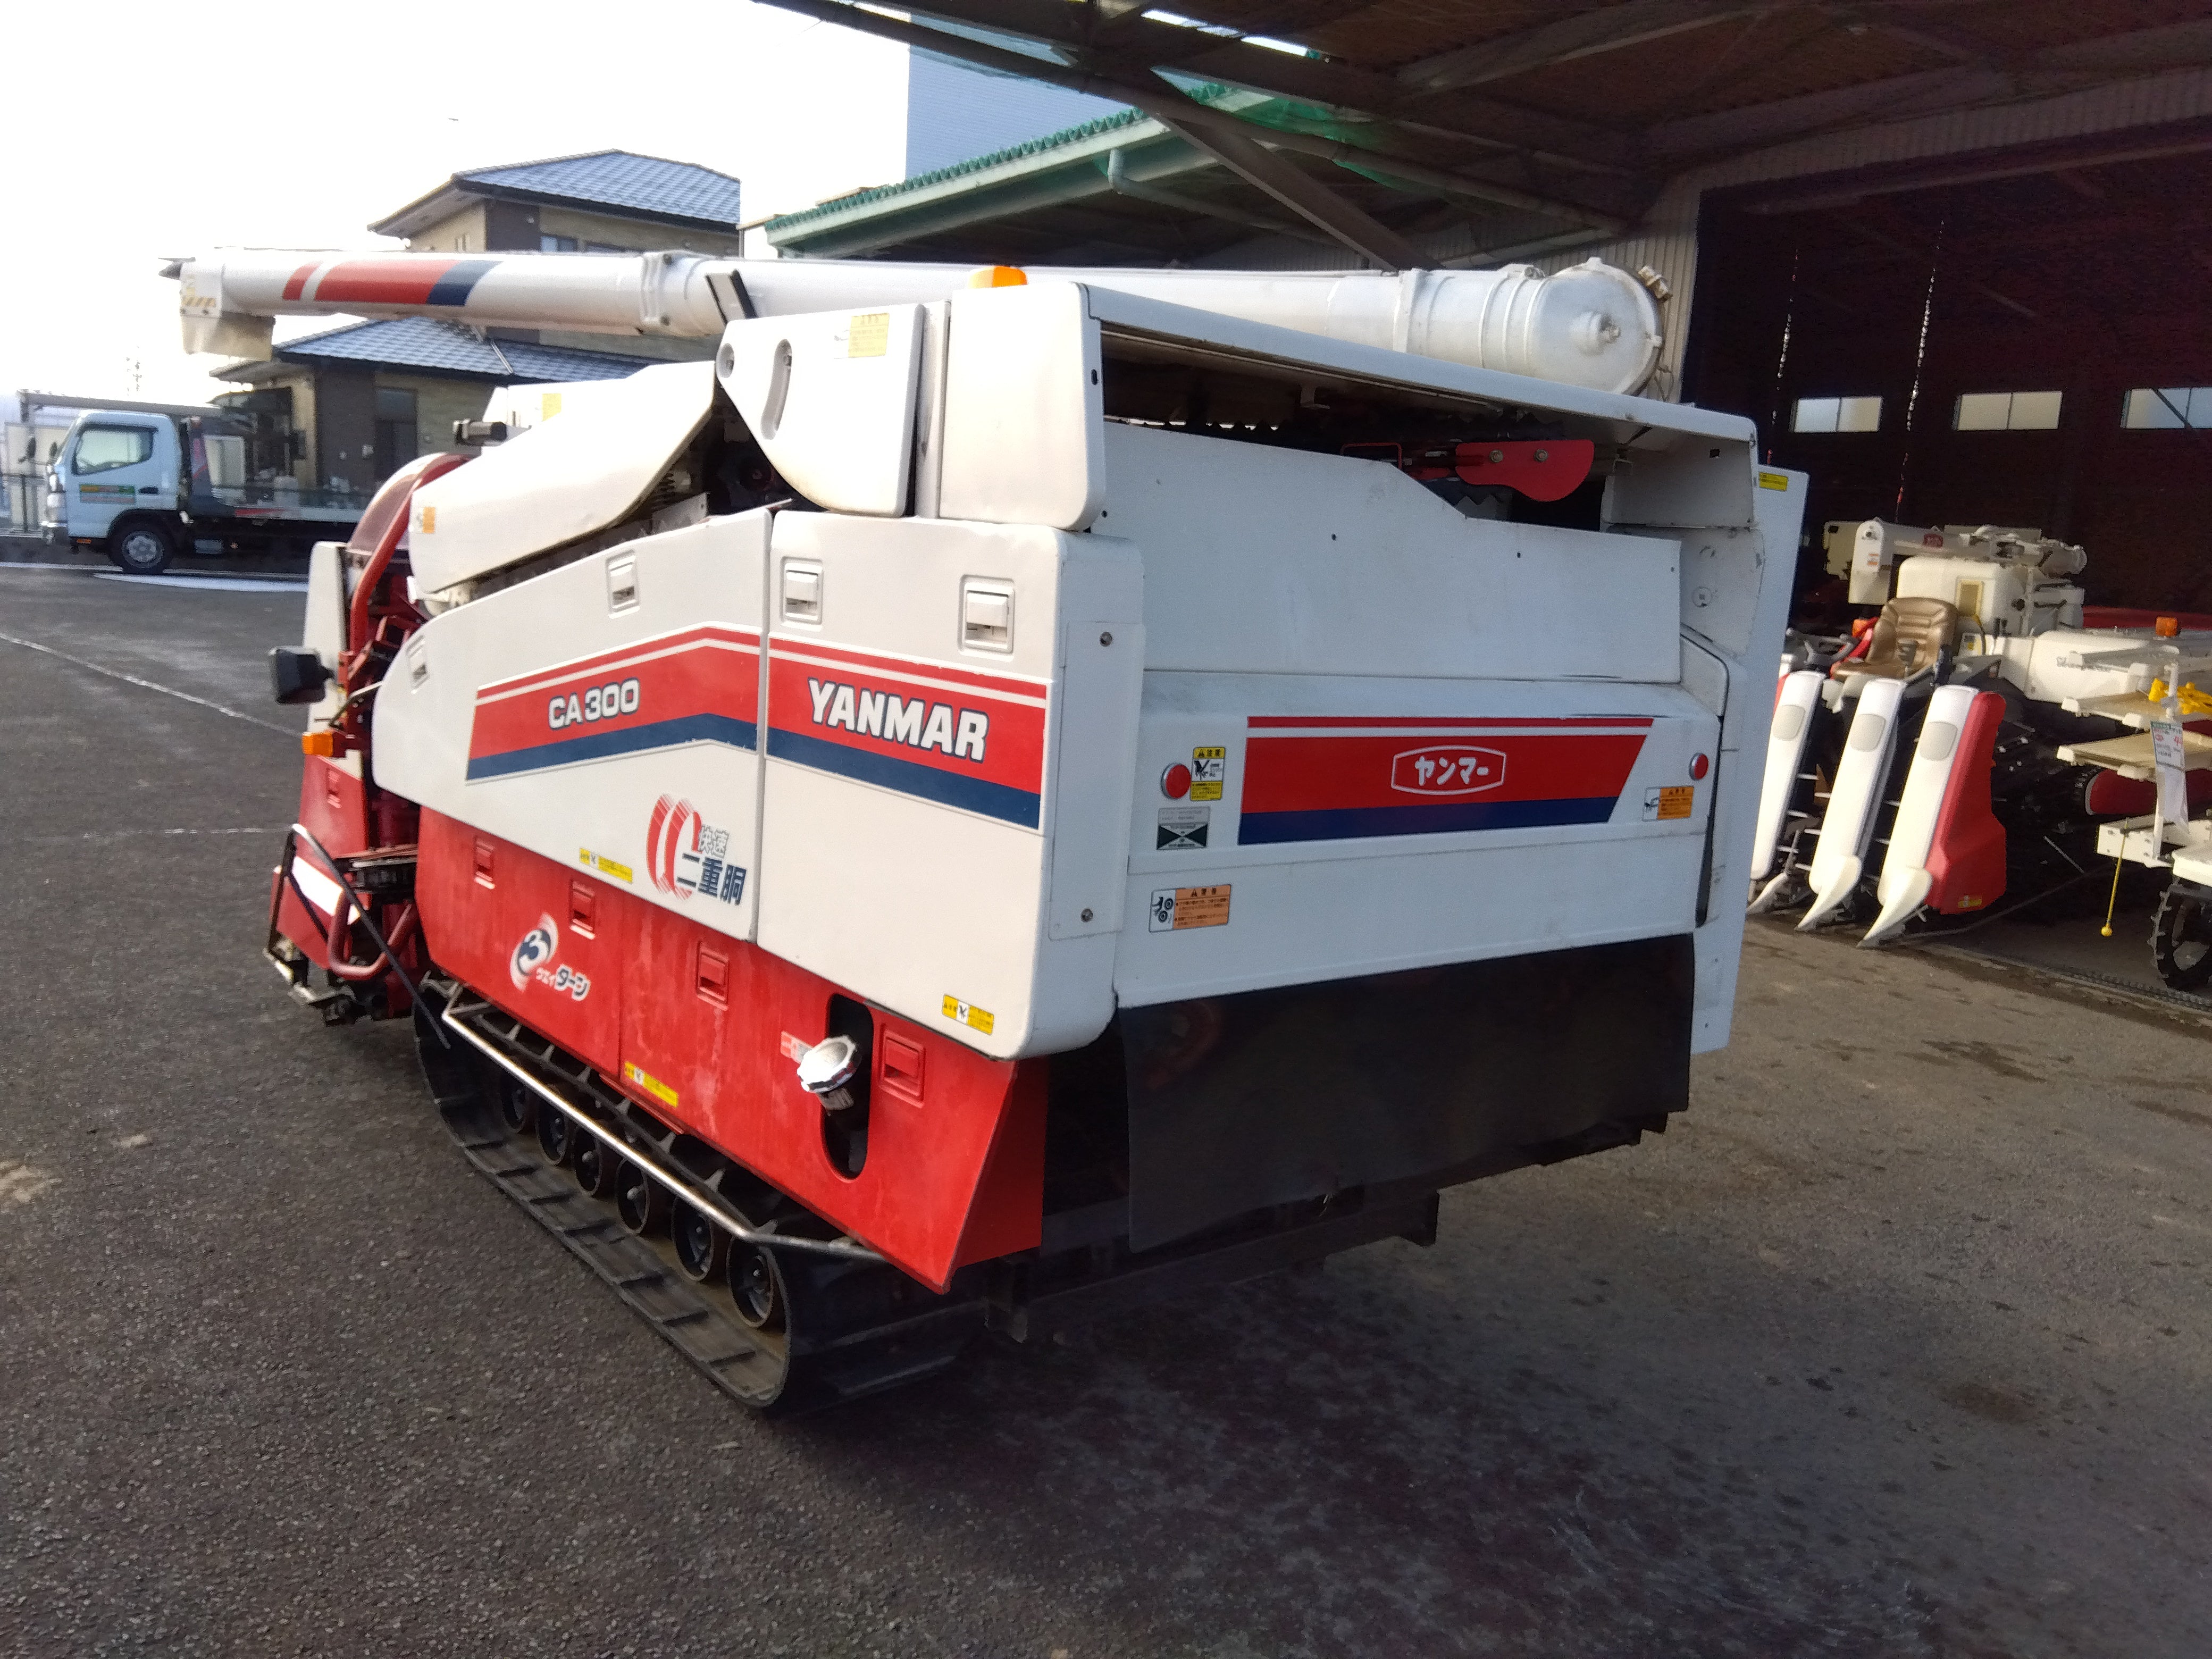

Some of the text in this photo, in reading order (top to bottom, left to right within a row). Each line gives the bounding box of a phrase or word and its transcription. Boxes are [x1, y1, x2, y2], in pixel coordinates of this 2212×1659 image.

[549, 677, 640, 730] CA300
[808, 677, 990, 764] YANMAR
[1414, 755, 1489, 786] ヤンマー
[698, 825, 730, 859] 快速
[676, 853, 747, 906] 二重胴
